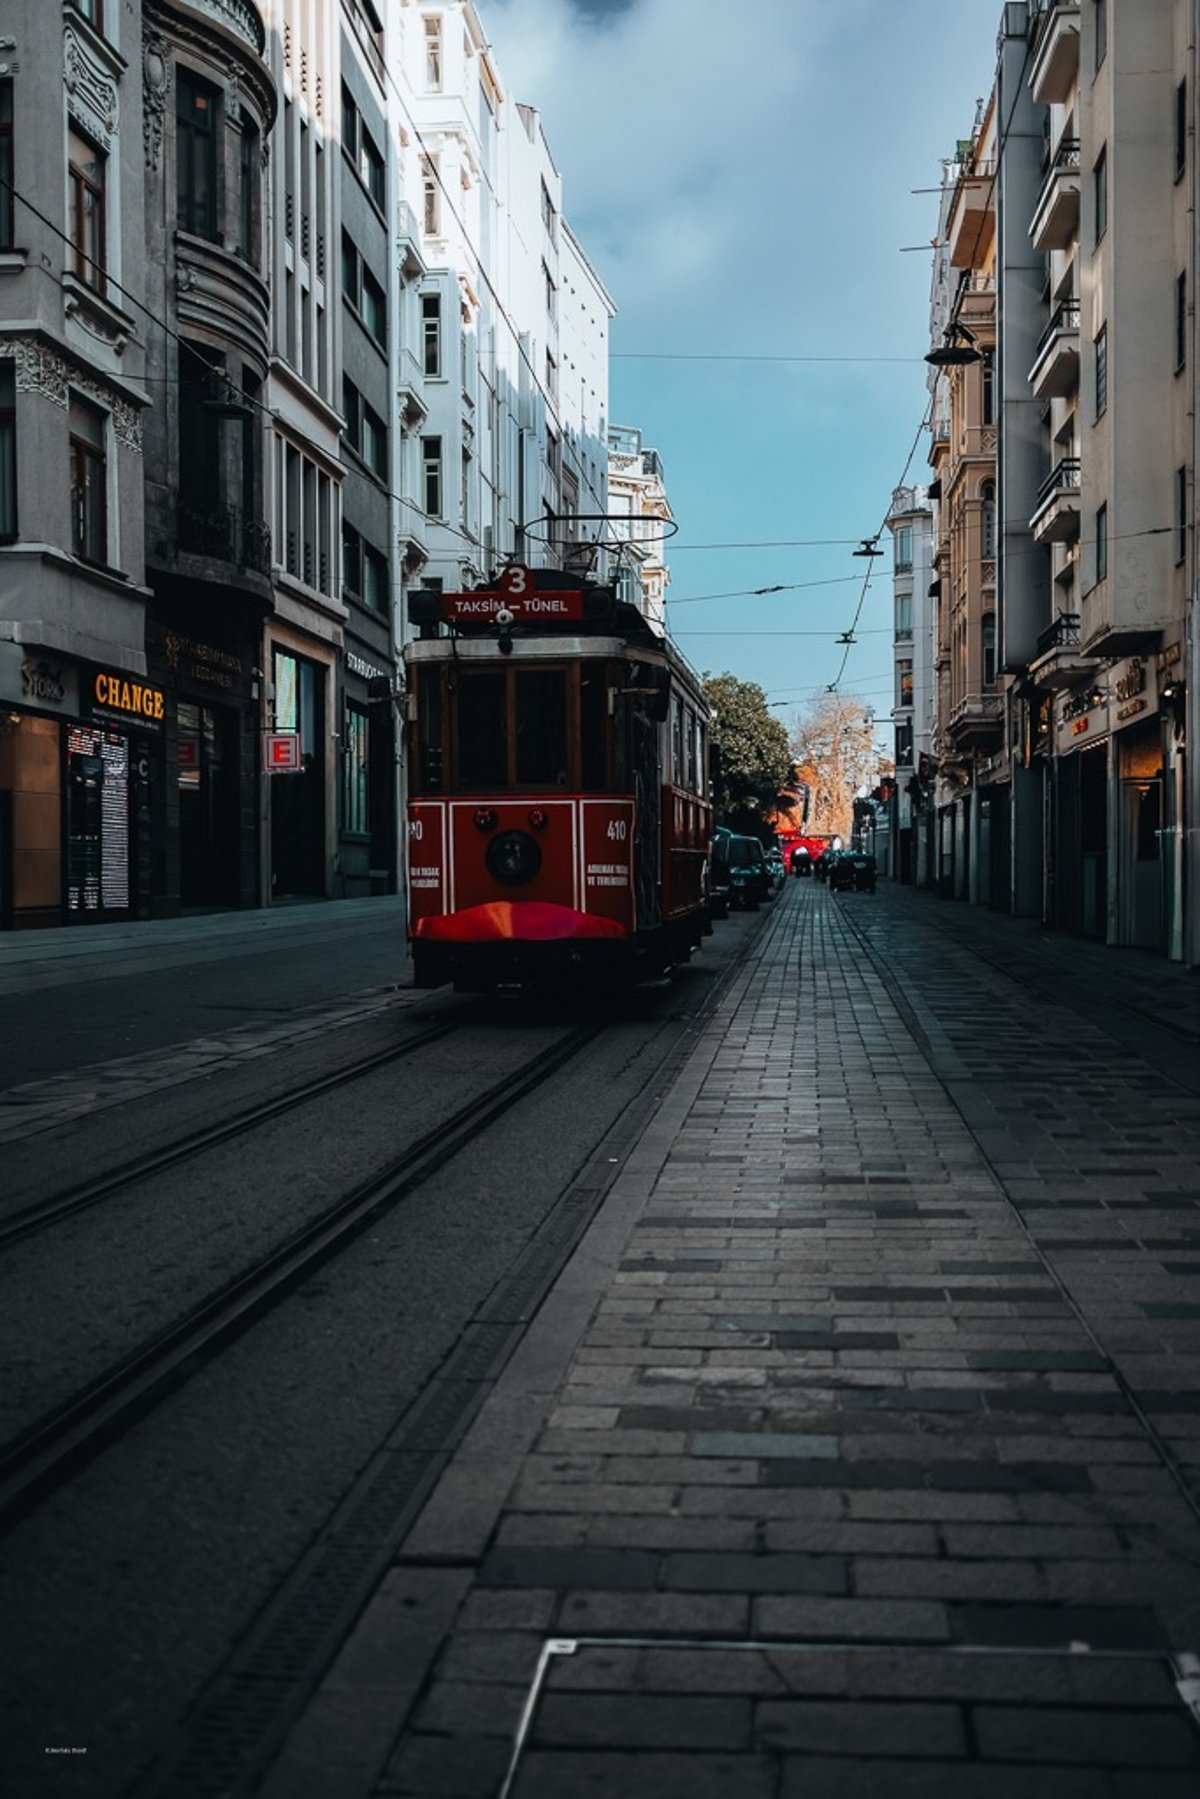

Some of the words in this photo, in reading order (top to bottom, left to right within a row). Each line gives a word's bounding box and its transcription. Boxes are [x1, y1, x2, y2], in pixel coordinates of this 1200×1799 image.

[508, 566, 527, 593] 3
[455, 598, 506, 612] TAKSİM
[523, 597, 568, 612] TÜNEL
[94, 673, 165, 720] CHANGE
[273, 741, 291, 763] E
[607, 820, 627, 841] 410
